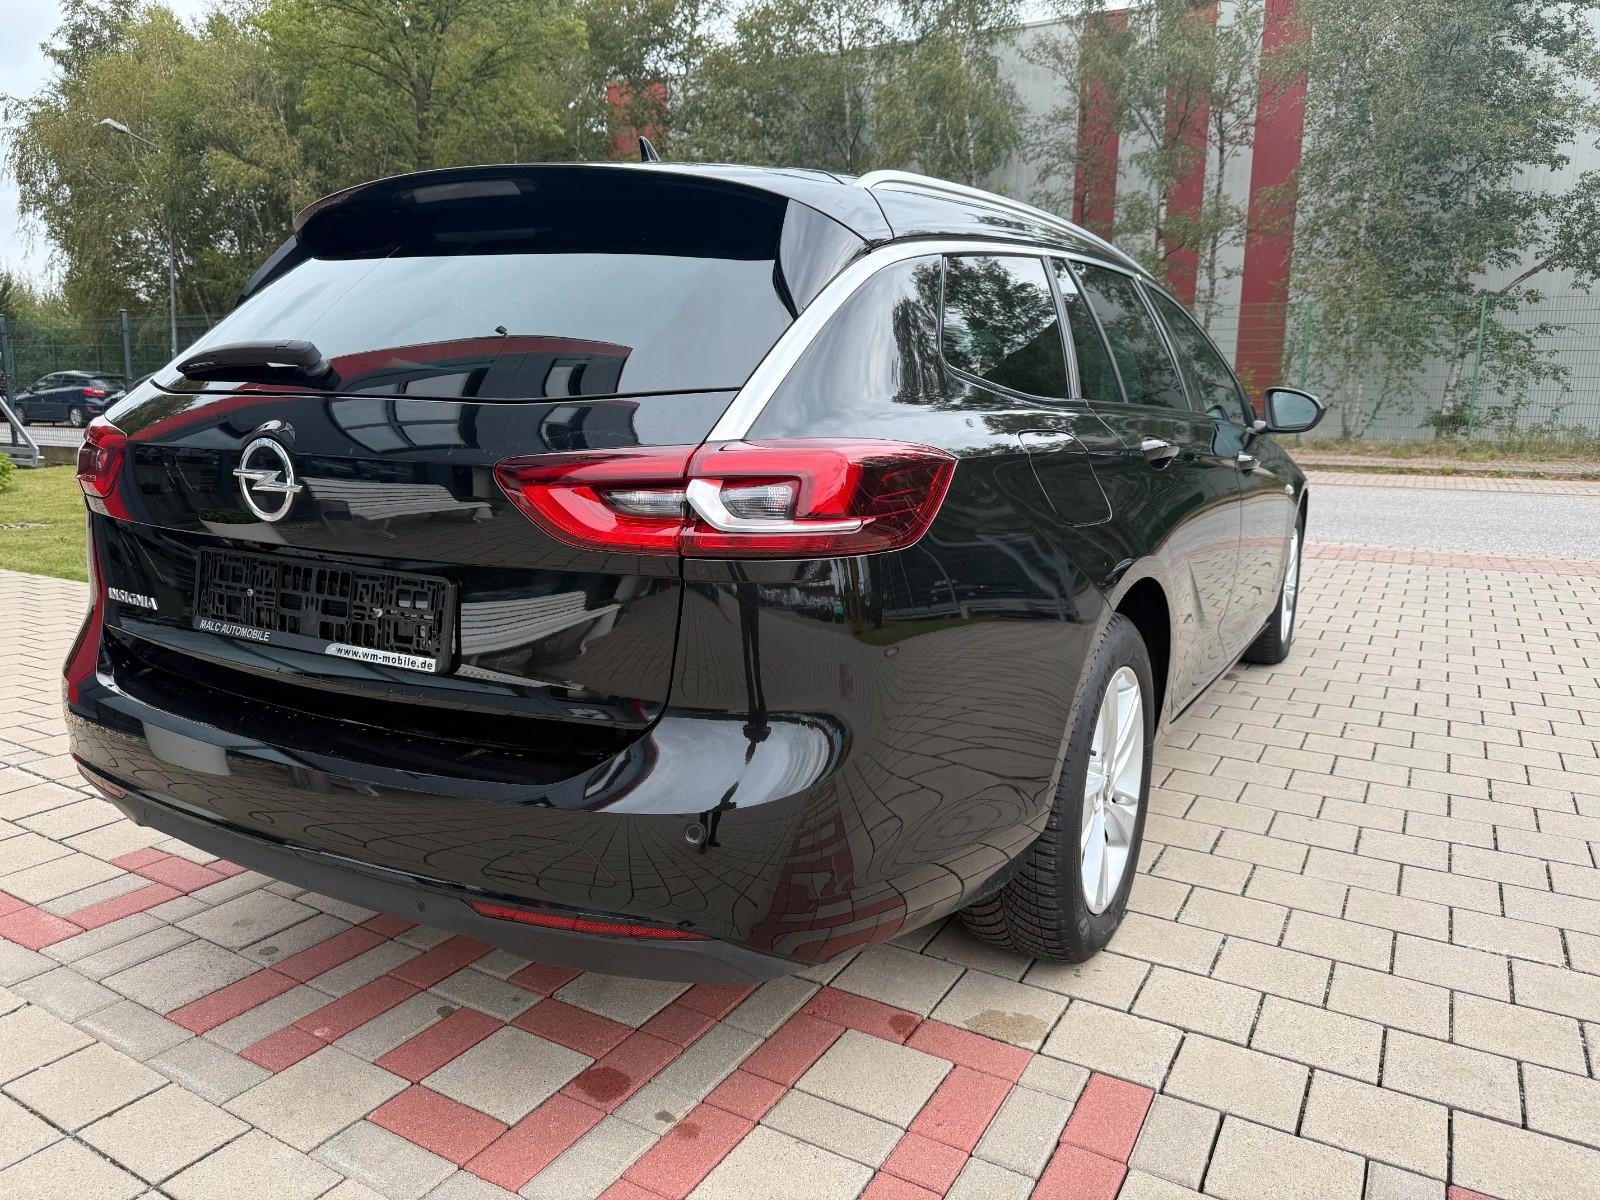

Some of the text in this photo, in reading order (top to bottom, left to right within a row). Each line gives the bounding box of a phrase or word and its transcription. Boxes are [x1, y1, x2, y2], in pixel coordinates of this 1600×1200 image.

[108, 586, 158, 611] INSIGNIA
[199, 619, 271, 642] MALC AUTOMOBILE
[336, 646, 434, 671] www.wm-mobile.de
